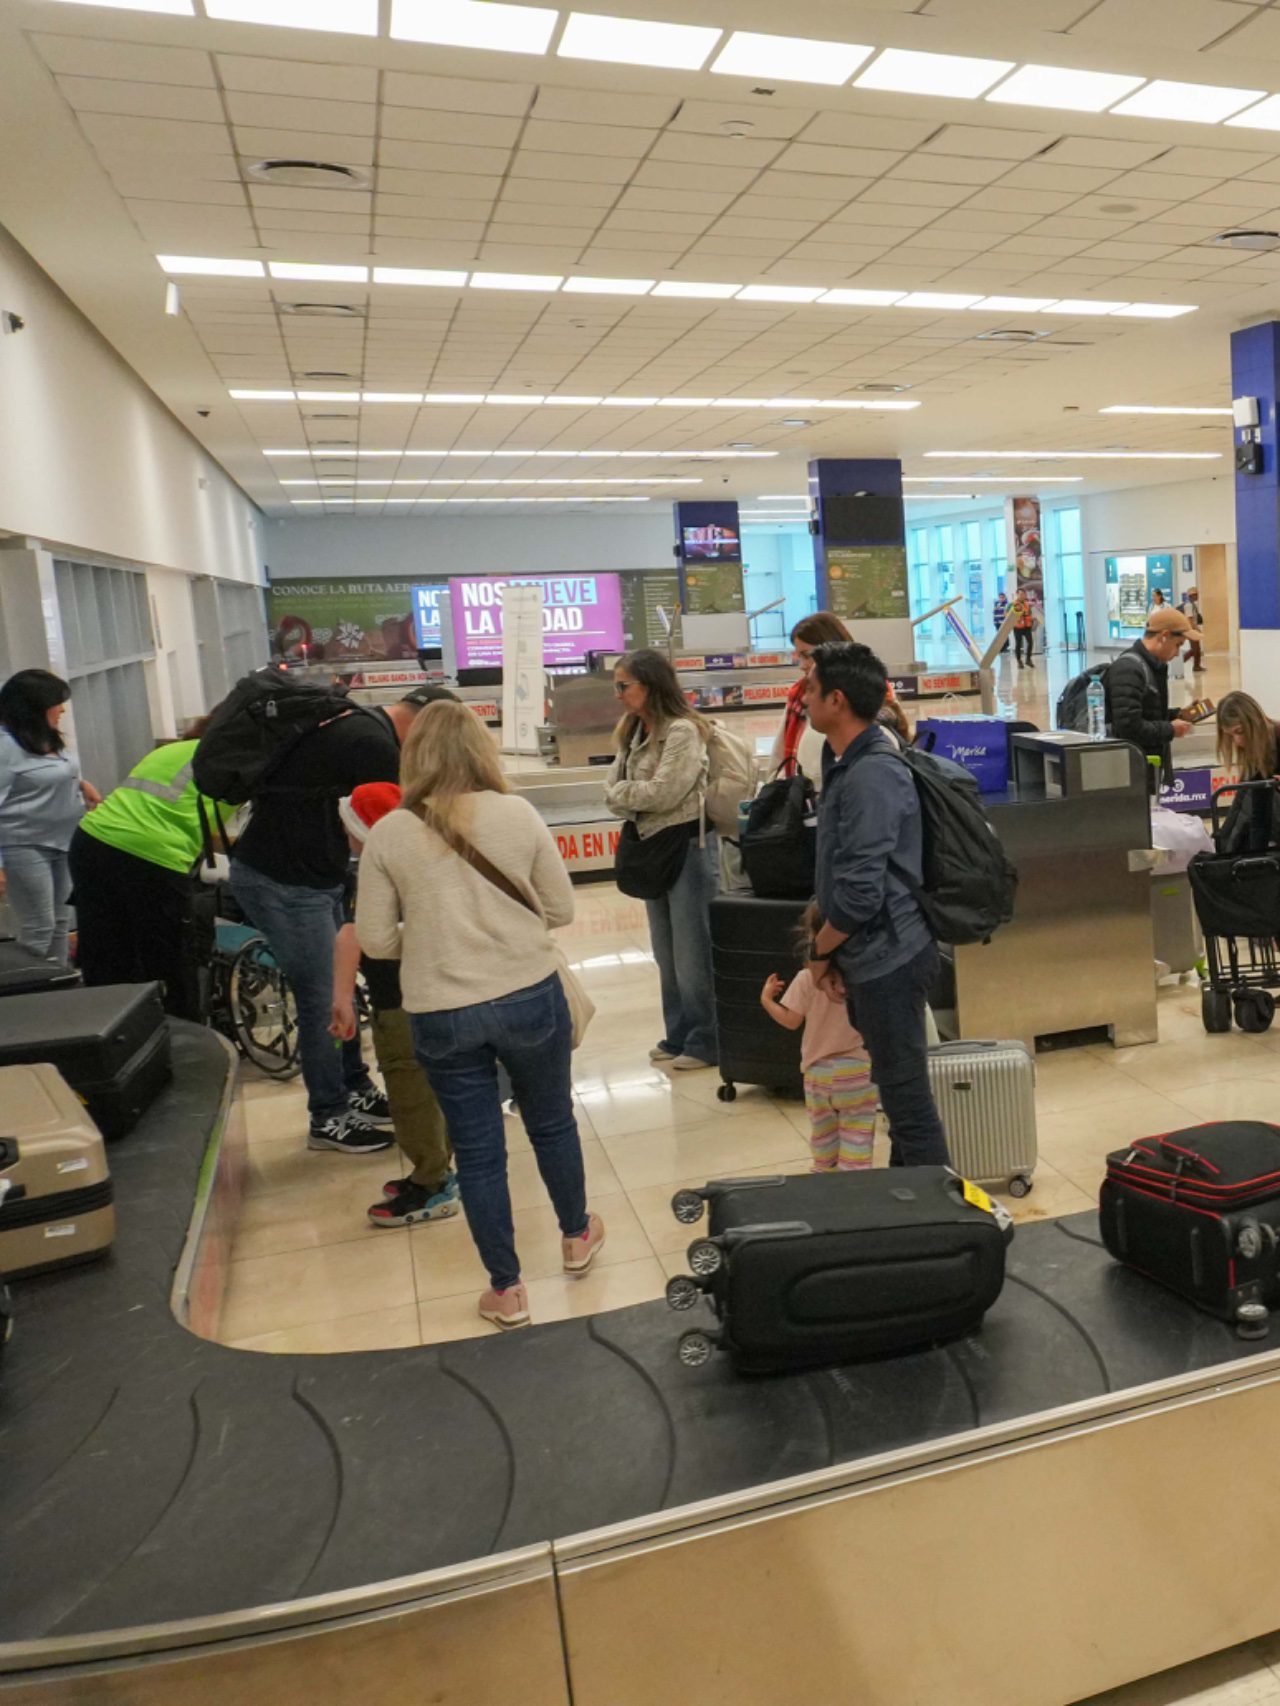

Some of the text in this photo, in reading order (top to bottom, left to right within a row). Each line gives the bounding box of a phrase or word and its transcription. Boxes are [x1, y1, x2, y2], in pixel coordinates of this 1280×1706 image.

[272, 585, 328, 596] CONOCE
[329, 584, 346, 594] LA
[350, 583, 384, 594] RUTA
[464, 611, 496, 635] LA
[582, 832, 604, 858] EN
